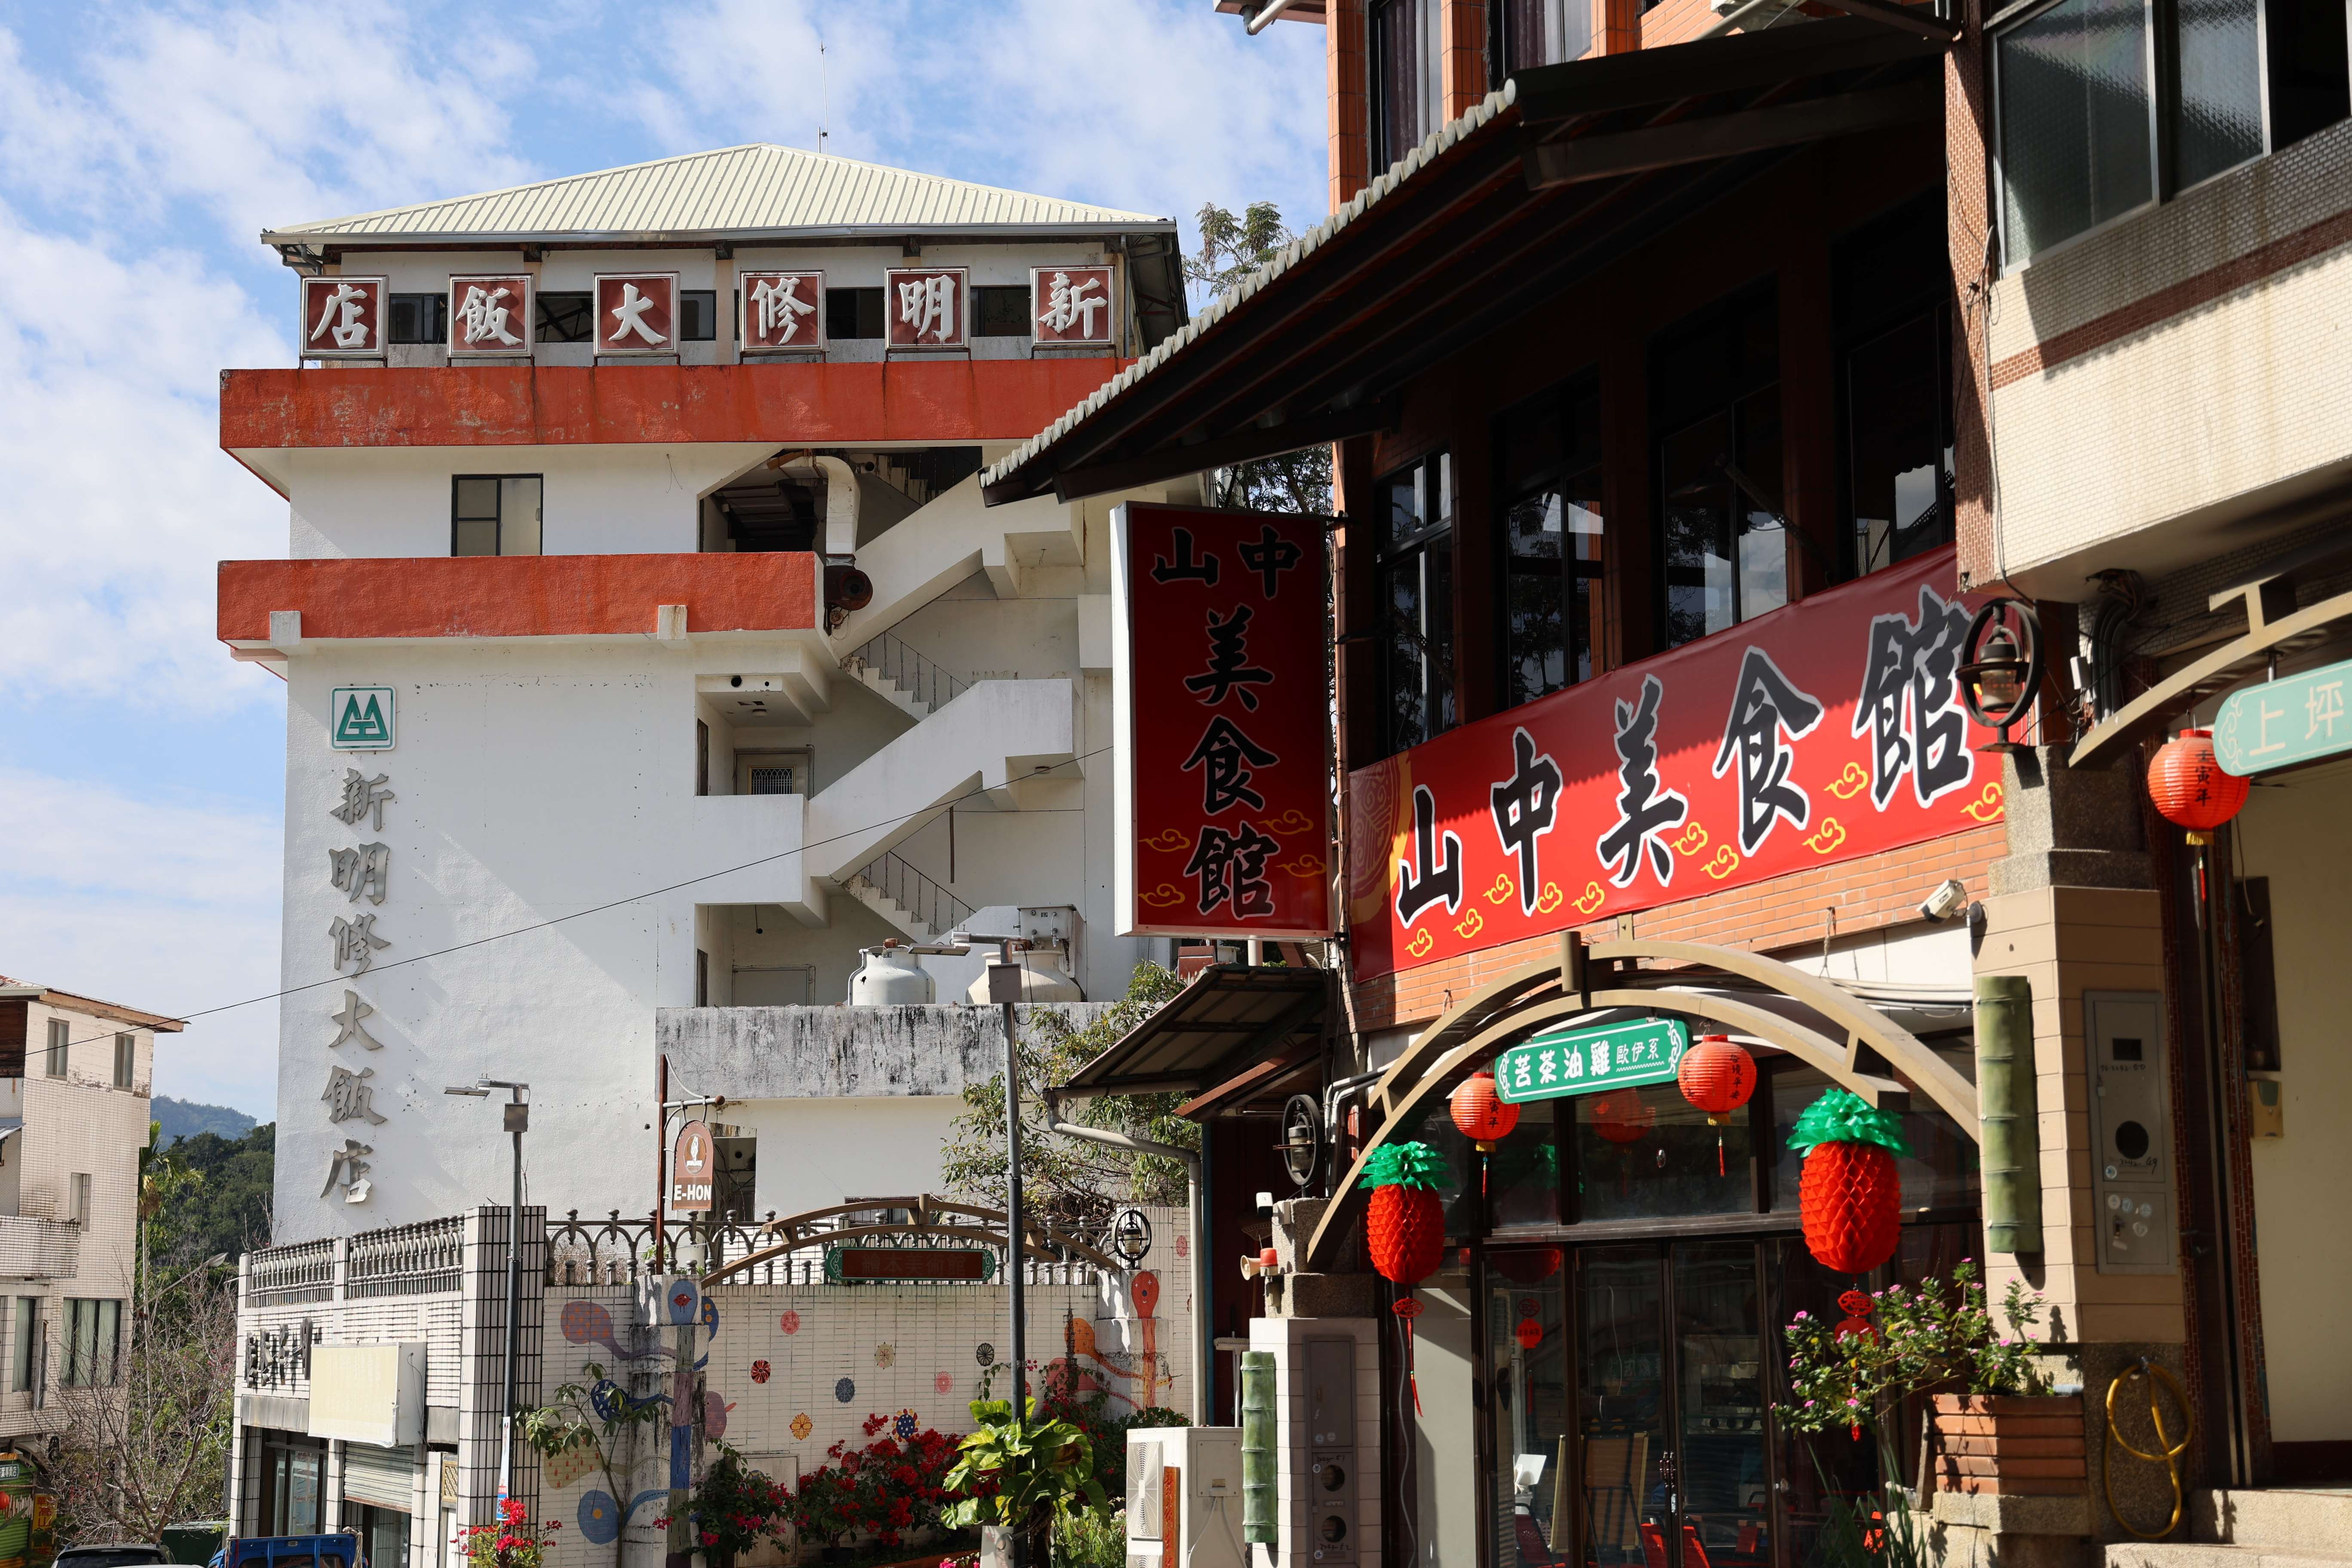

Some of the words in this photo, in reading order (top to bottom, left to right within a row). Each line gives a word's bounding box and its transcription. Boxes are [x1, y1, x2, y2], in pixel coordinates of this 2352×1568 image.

[2249, 681, 2344, 756] 上坪
[1181, 603, 1280, 920] 美食館
[1395, 584, 1975, 929] 山中美食館
[2195, 750, 2213, 807] 壬寅年
[320, 767, 394, 1203] 新明修大飯店
[1514, 1040, 1611, 1088] 苦茶油雞
[1616, 1038, 1660, 1065] 歐伊系
[674, 1185, 712, 1200] E-HON
[862, 1251, 966, 1276] 繪本美術館
